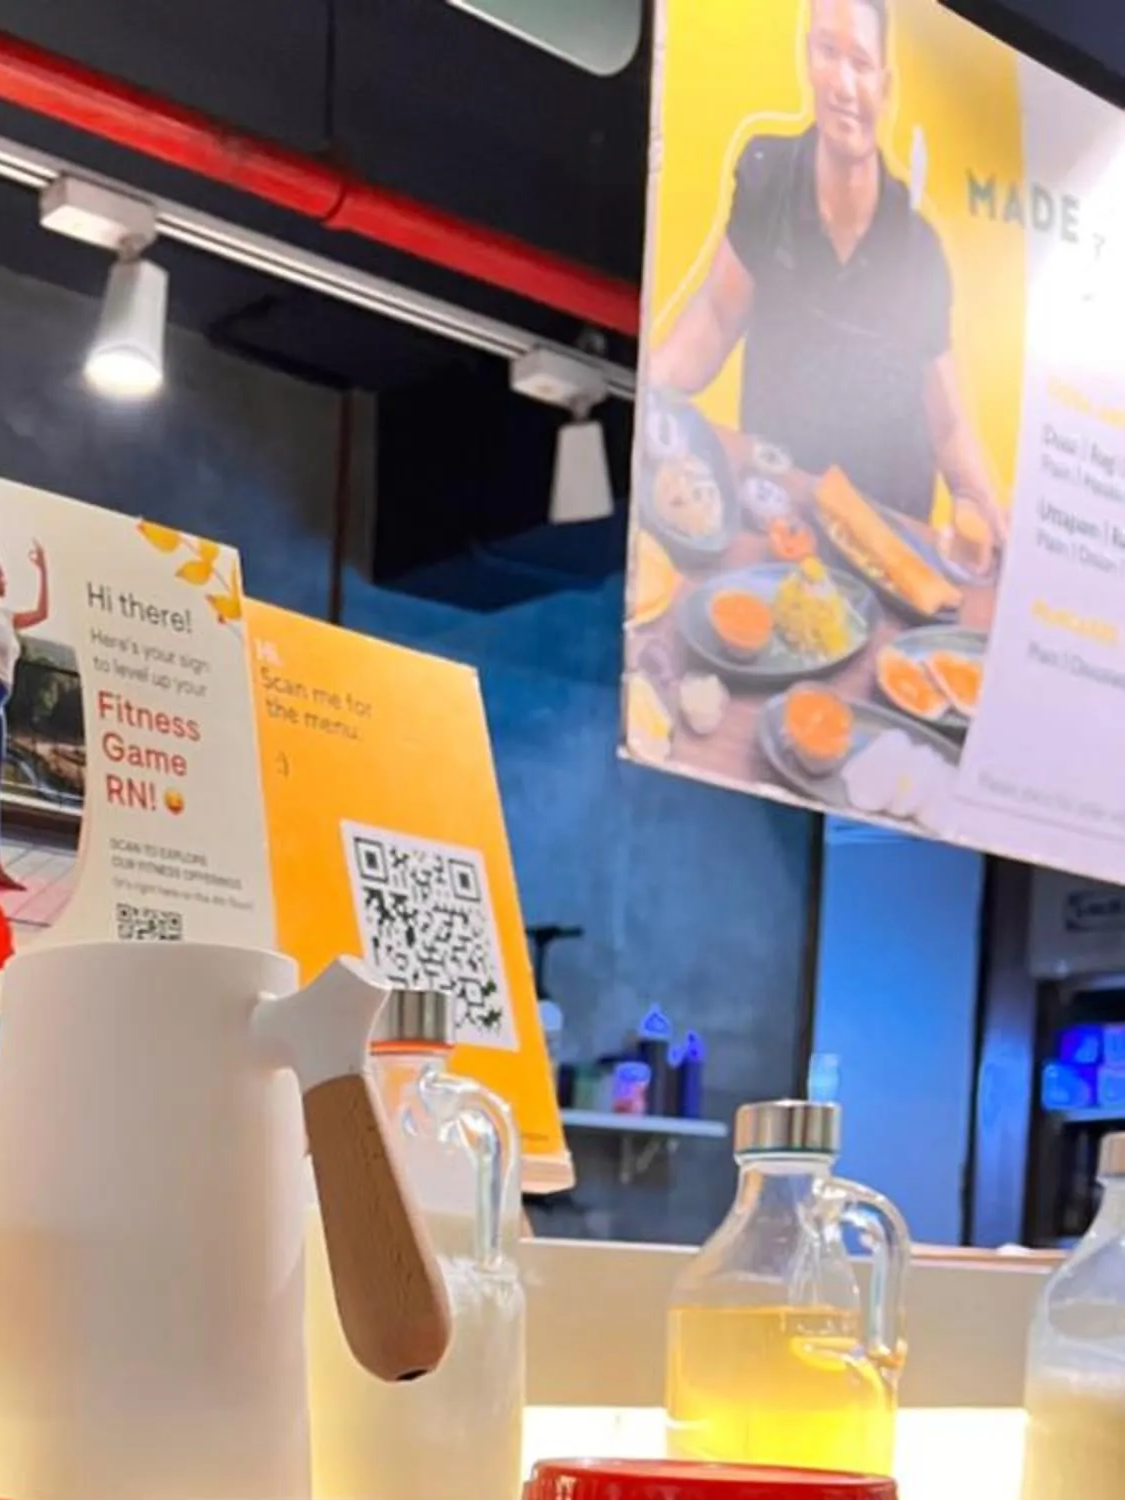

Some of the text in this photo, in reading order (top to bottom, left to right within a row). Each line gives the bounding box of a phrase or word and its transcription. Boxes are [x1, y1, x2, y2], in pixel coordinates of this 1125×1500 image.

[965, 168, 1079, 243] MADE
[87, 581, 192, 634] Hi there!
[91, 628, 139, 656] Here's
[142, 645, 175, 664] your
[93, 656, 208, 698] to level up your
[260, 666, 372, 718] Scan me for
[97, 690, 201, 742] Fitness
[266, 699, 299, 725] the
[102, 731, 187, 776] Game
[106, 773, 157, 811] RN!
